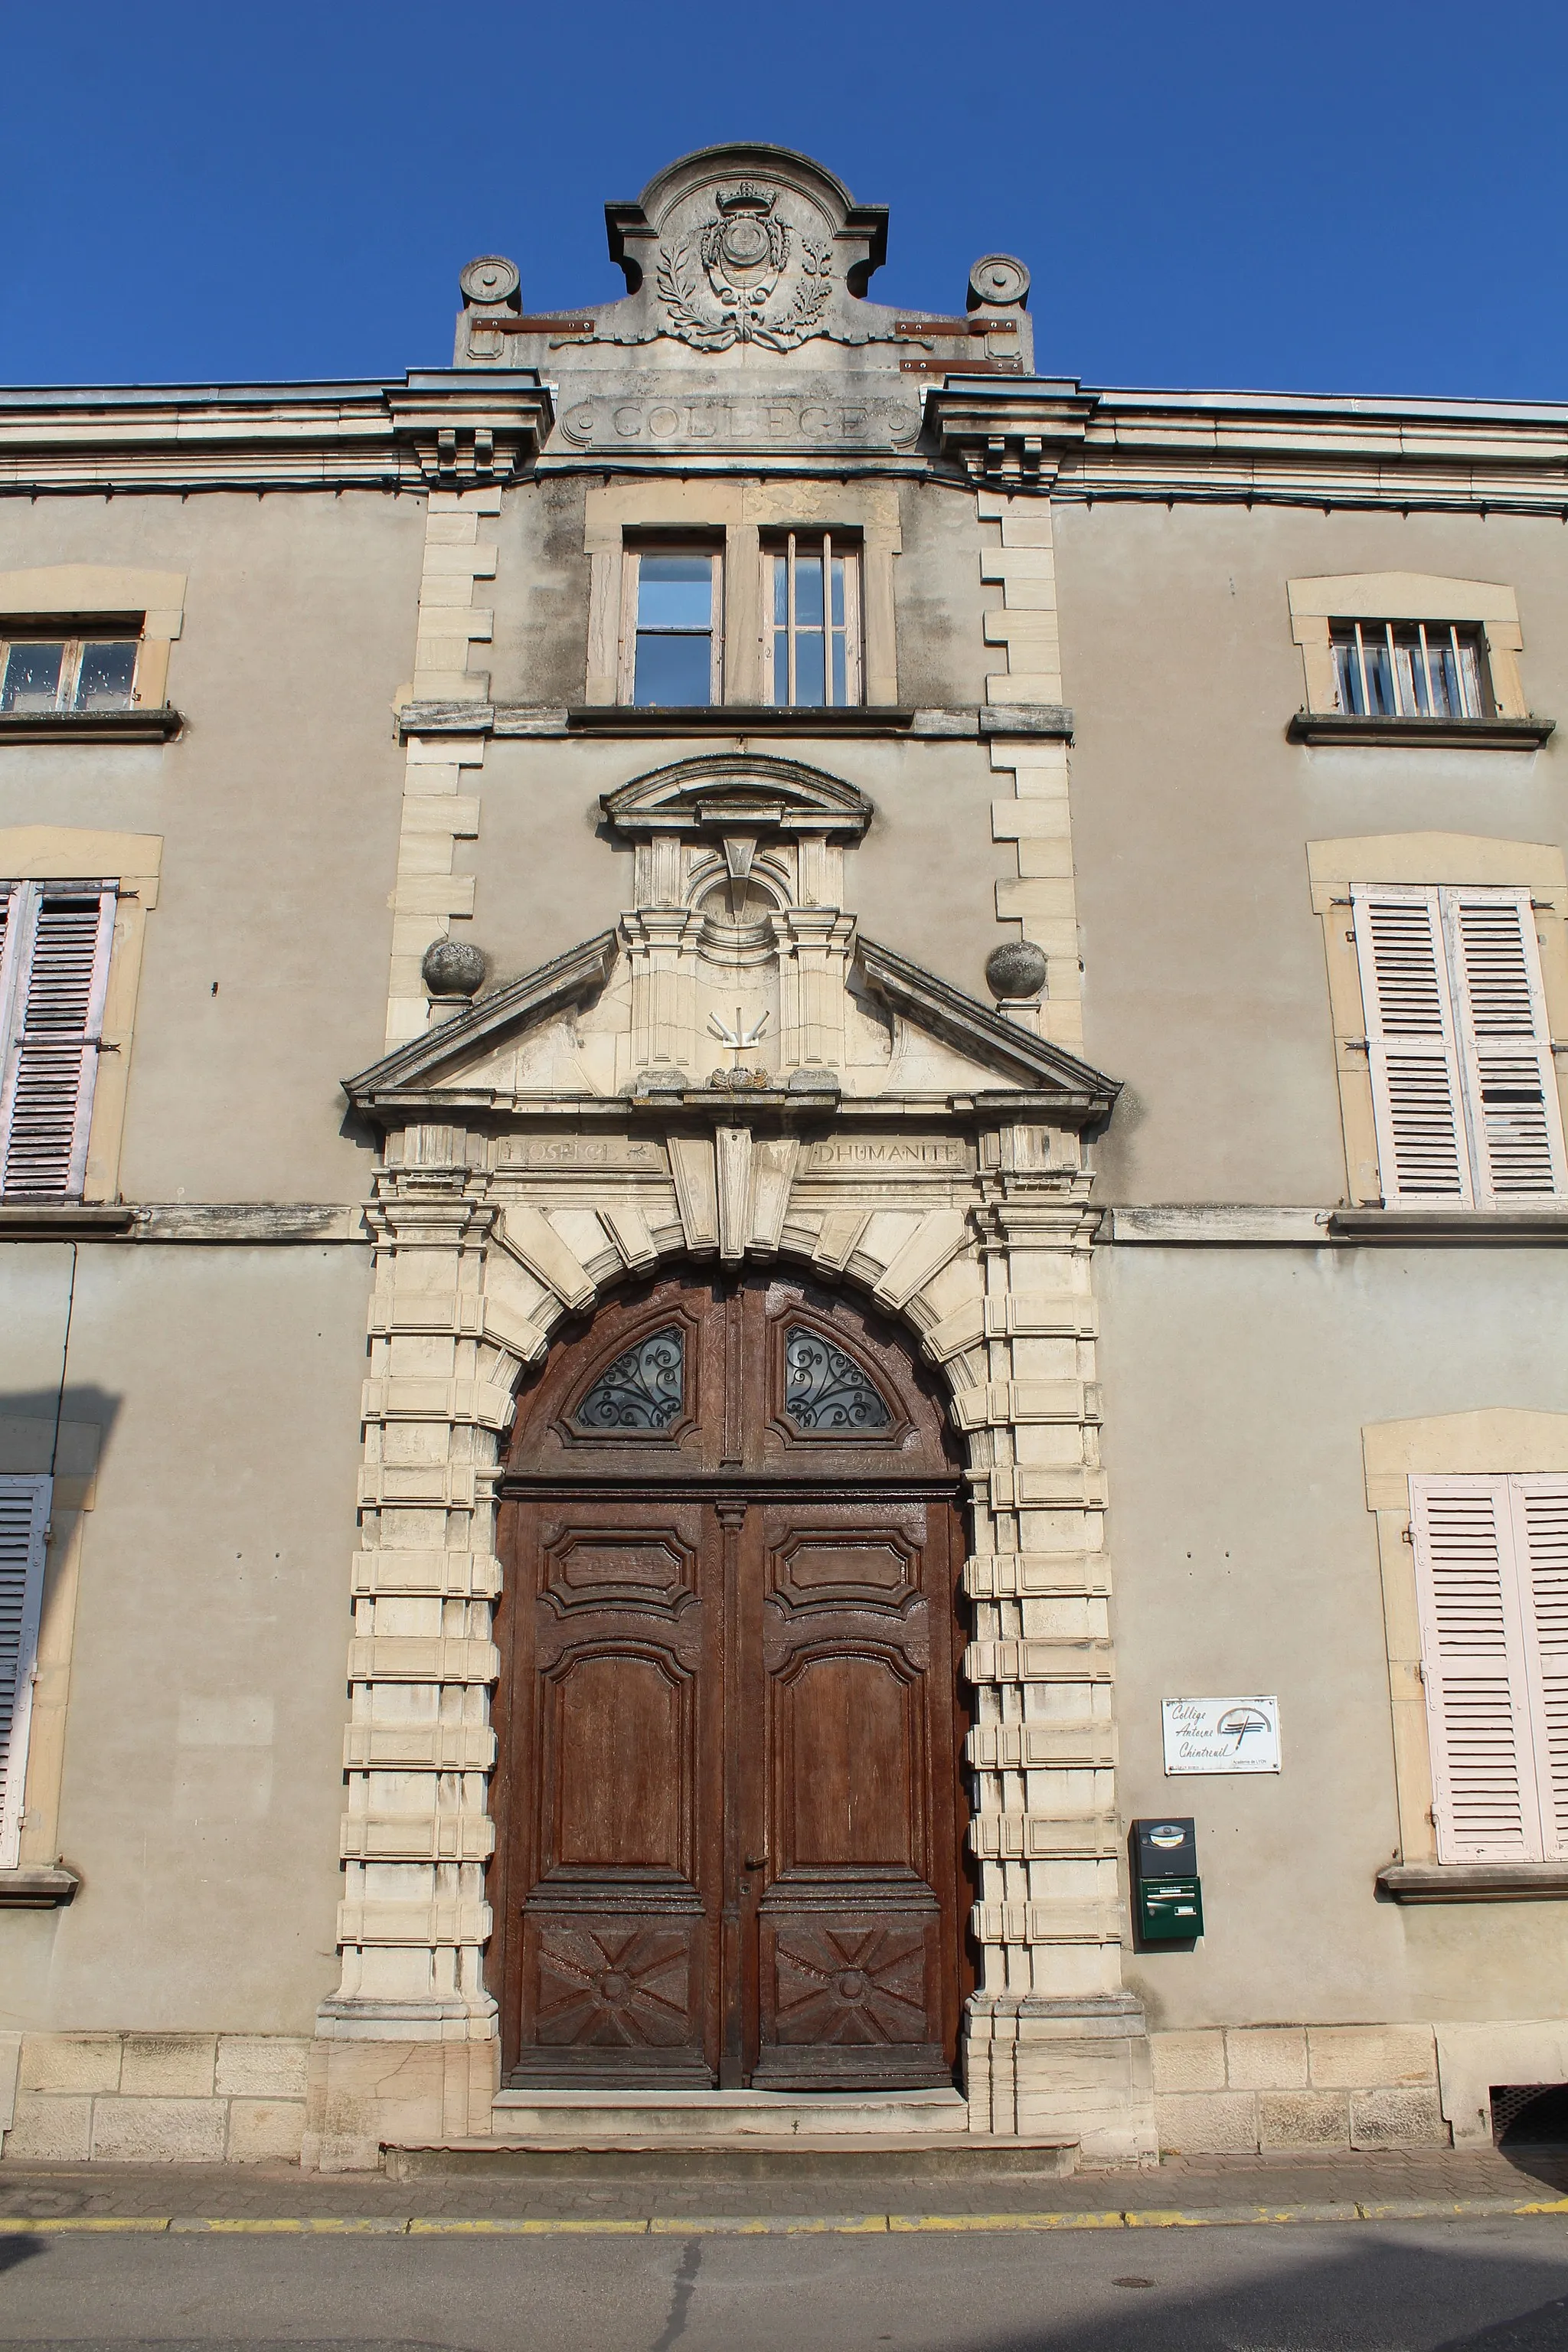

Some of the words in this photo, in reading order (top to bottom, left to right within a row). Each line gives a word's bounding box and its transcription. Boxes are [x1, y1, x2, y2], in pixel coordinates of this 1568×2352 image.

[613, 406, 868, 438] COLLEGE
[1172, 1704, 1206, 1725] Collège
[1176, 1723, 1213, 1737] Antoine
[1179, 1742, 1230, 1758] Chintreuil
